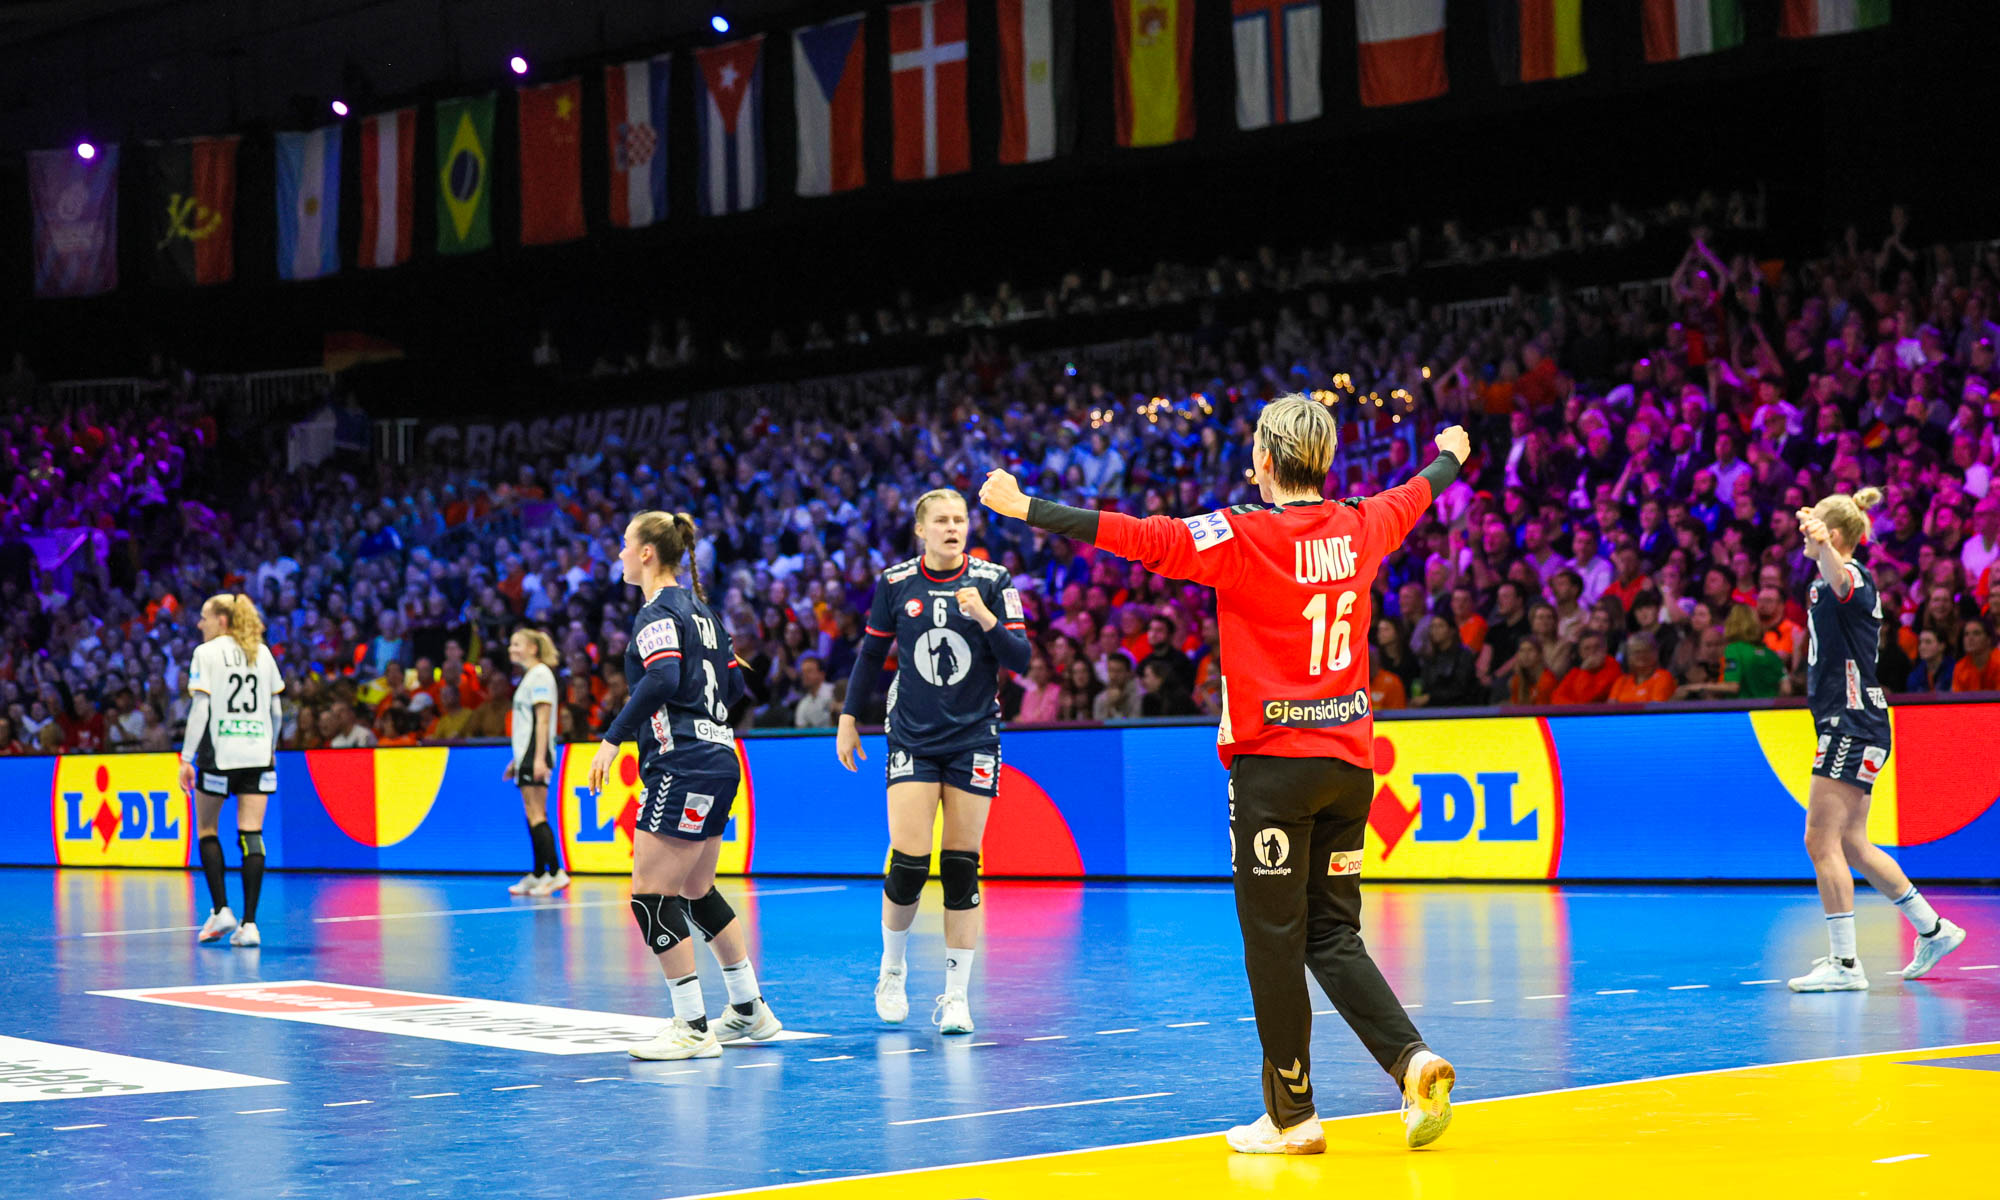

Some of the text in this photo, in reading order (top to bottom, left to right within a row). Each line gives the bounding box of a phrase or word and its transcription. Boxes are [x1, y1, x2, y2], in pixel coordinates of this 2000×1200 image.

[1295, 535, 1358, 583] LUNDE
[933, 597, 948, 628] 6
[643, 635, 672, 655] 1000
[1302, 590, 1358, 676] 16
[227, 673, 258, 713] 23
[1265, 700, 1355, 723] Gjensidige
[1368, 736, 1538, 862] iDL
[1252, 867, 1292, 876] Gjensidige
